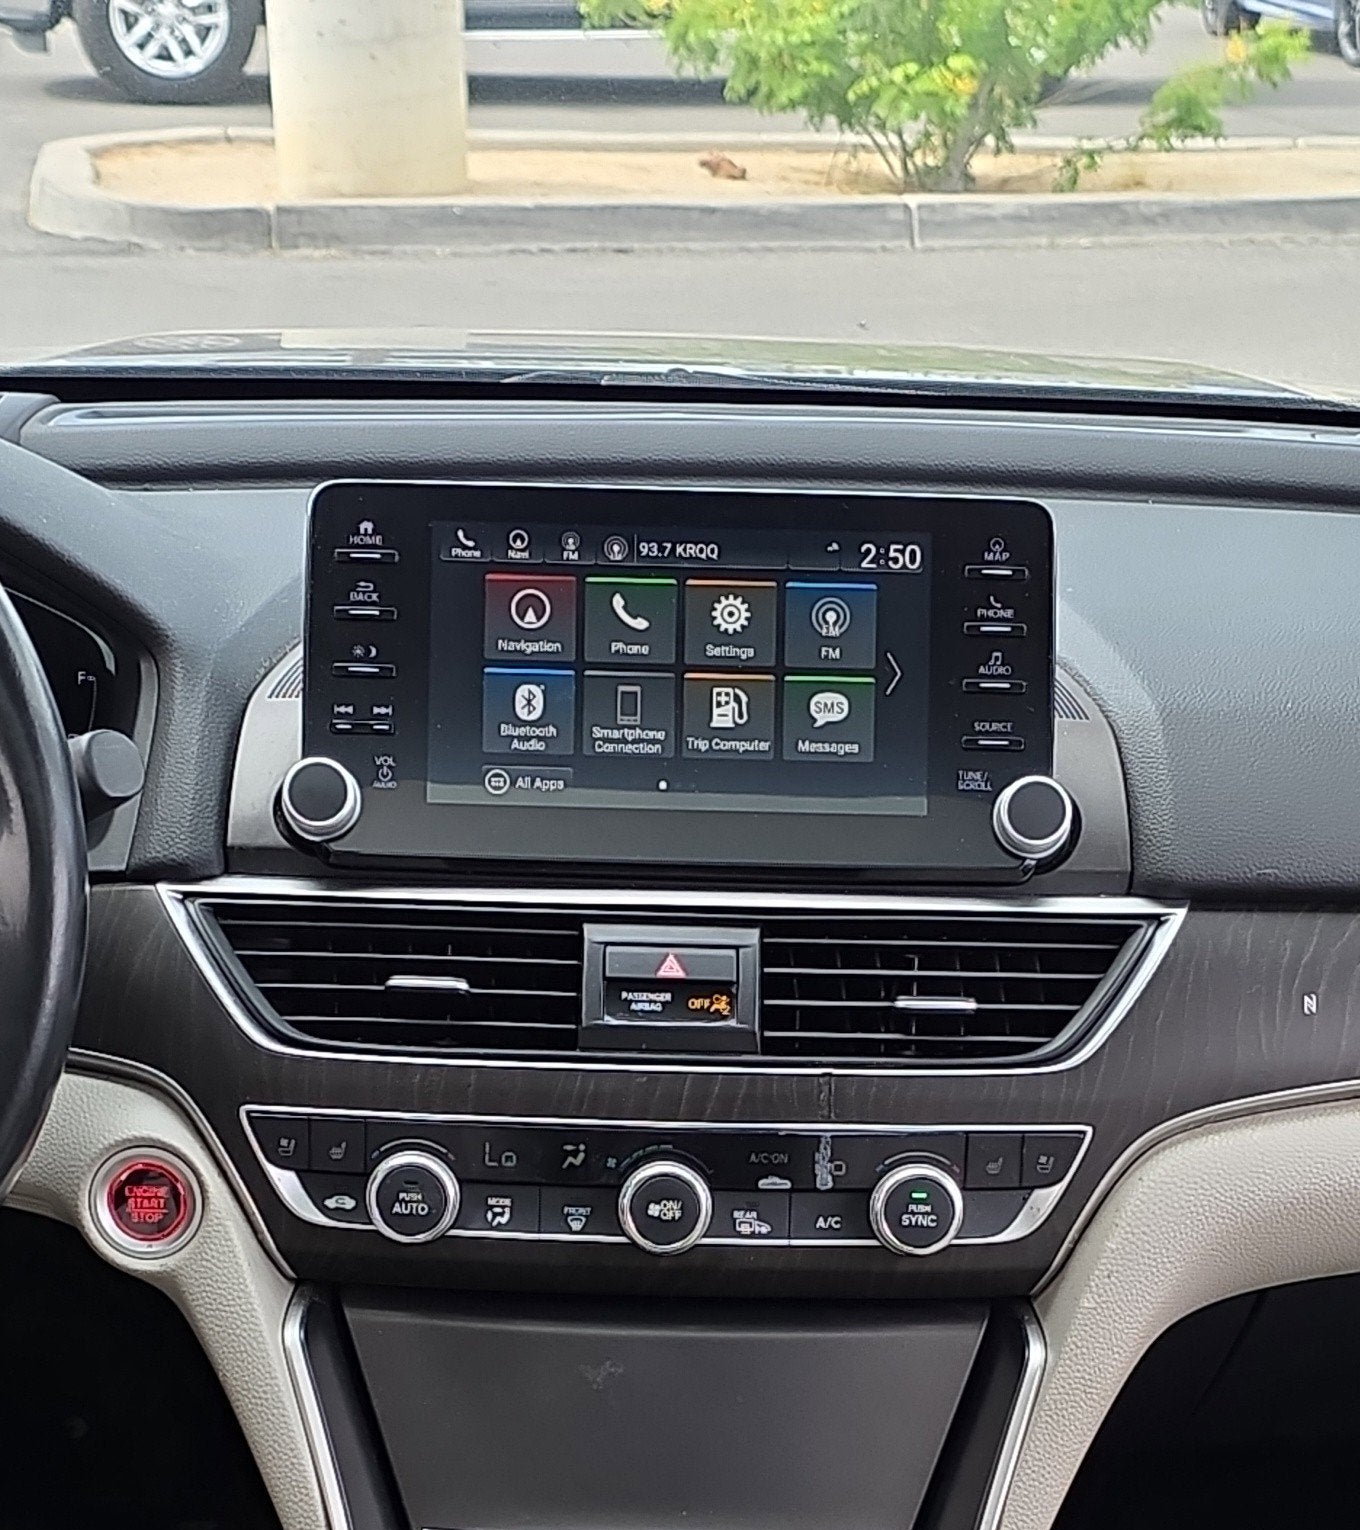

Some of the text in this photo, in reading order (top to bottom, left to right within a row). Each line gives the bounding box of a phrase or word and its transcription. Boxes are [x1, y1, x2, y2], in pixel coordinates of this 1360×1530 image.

[349, 534, 383, 545] HOME
[451, 548, 481, 559] Phone
[507, 549, 529, 560] Navi
[562, 551, 579, 560] FM
[639, 541, 719, 560] 93.7 KRQQ
[859, 543, 922, 570] 2:50
[984, 552, 1010, 561] MAP
[349, 591, 379, 602] BACK
[976, 608, 1014, 619] PHONE
[497, 639, 562, 655] Navigation
[610, 642, 650, 655] Phone
[705, 644, 755, 659] Settings
[821, 647, 841, 660] FM
[978, 665, 1012, 676] AUDIO
[813, 700, 845, 715] SMS
[500, 723, 557, 738] Bluetooth
[973, 721, 1014, 732] SOURCE
[592, 726, 666, 742] Smartphone
[511, 739, 547, 751] Audio
[594, 741, 662, 755] Connection
[686, 737, 771, 754] Trip Computer
[797, 739, 860, 756] Messages
[373, 756, 396, 767] VOL
[958, 770, 989, 781] TUNE/
[515, 777, 565, 791] All Apps
[957, 781, 993, 791] SCROLL
[621, 991, 672, 1002] PASSENGER
[630, 1002, 662, 1012] AIRBAG
[687, 998, 711, 1009] OFF
[124, 1185, 170, 1197] ENGINE
[398, 1192, 423, 1201] PUSH
[127, 1198, 166, 1209] START
[487, 1197, 512, 1206] MODE
[391, 1203, 430, 1216] AUTO
[562, 1206, 592, 1216] FRONT
[907, 1203, 932, 1213] PUSH
[131, 1212, 164, 1223] STOP
[660, 1209, 682, 1220] OFF
[733, 1210, 758, 1219] REAR
[815, 1216, 842, 1229] A/C
[901, 1214, 938, 1228] SYNC
